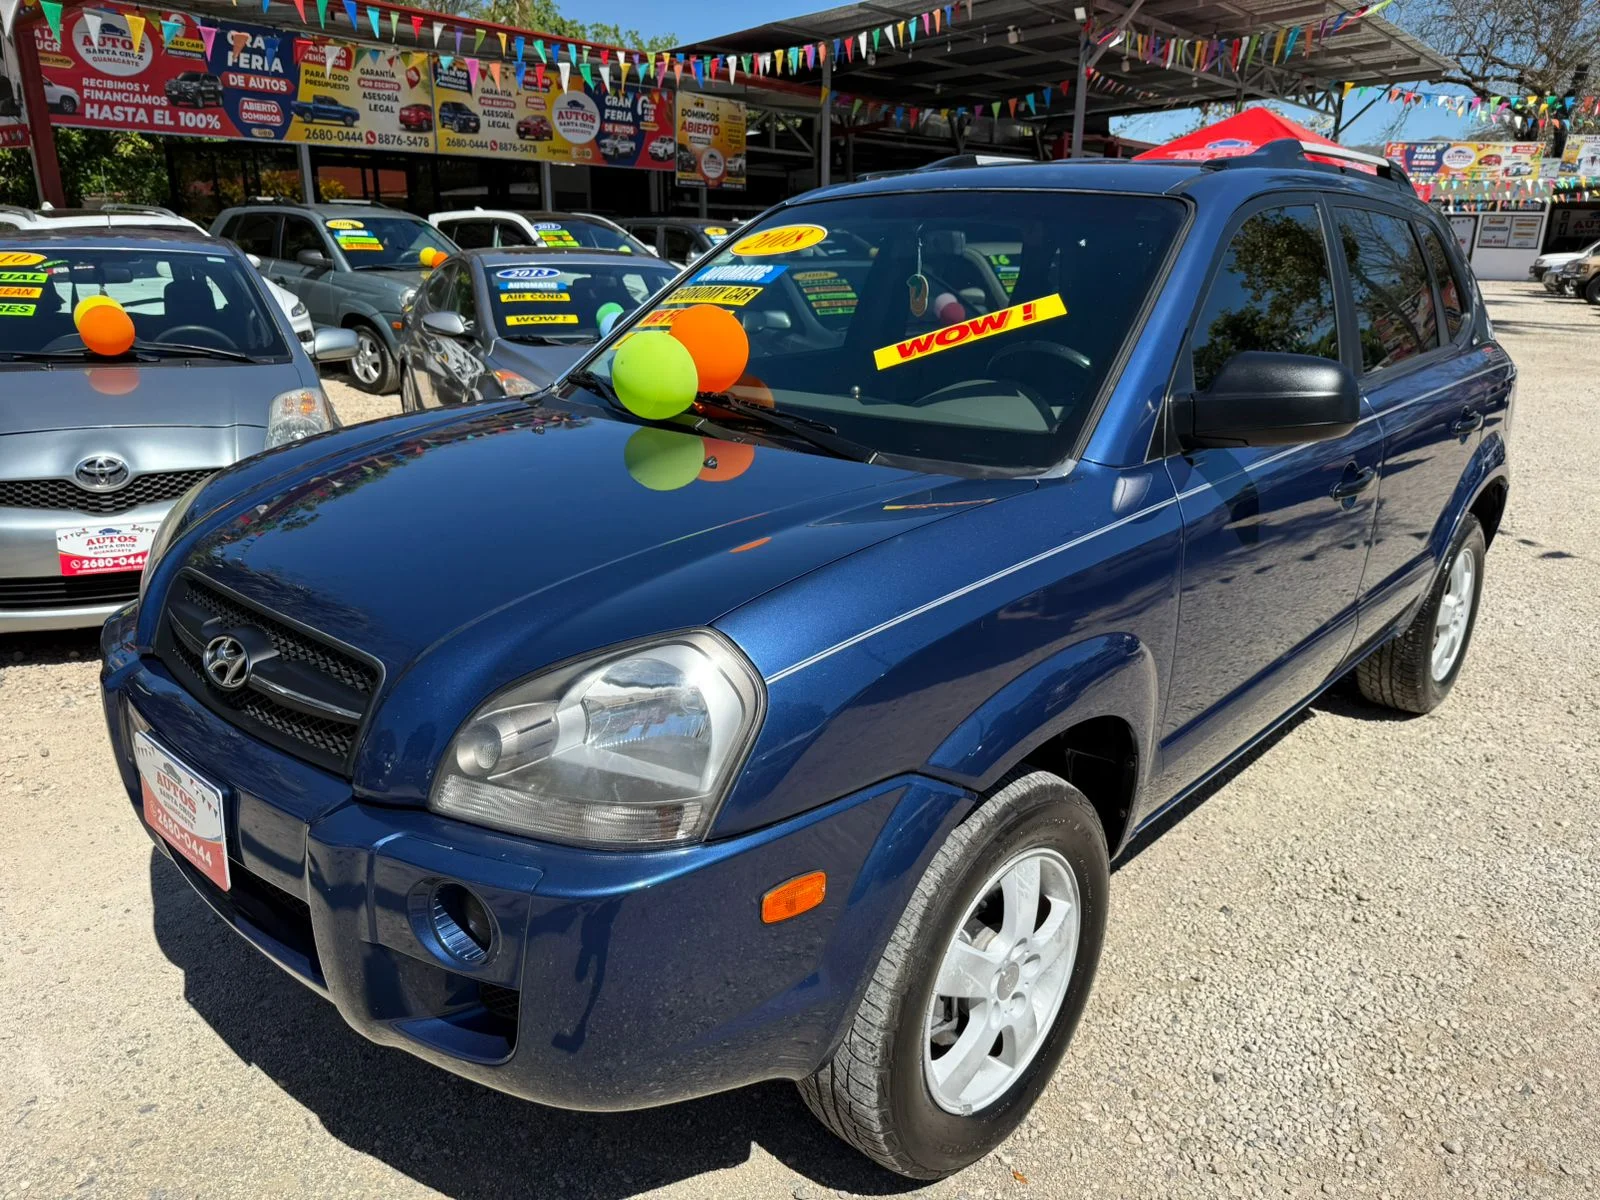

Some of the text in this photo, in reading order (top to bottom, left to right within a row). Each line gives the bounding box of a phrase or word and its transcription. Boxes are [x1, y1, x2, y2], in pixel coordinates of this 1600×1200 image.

[36, 40, 61, 52] UCR
[82, 34, 146, 53] AUTOS
[227, 30, 279, 52] GRA
[85, 48, 144, 61] SANTA CRUZ
[92, 56, 140, 67] GUANACASTE
[227, 51, 284, 73] FERIA
[305, 69, 350, 82] PARA TODO
[360, 68, 396, 79] GARANTÍA
[82, 78, 150, 92] RECIBIMOS Y
[228, 74, 287, 92] DE AUTOS
[305, 78, 350, 91] PRESUPUESTO
[360, 80, 399, 90] POR ESCRITO
[83, 90, 168, 106] FINANCIAMOS
[363, 91, 400, 102] ASESORÍA
[605, 96, 631, 108] GRAN
[243, 102, 277, 112] ABIERTO
[369, 103, 396, 113] LEGAL
[85, 103, 221, 129] HASTA EL 100%
[242, 111, 281, 122] DOMINGOS
[482, 109, 514, 119] ASESORÍA
[557, 111, 596, 124] AUTOS
[604, 109, 633, 122] FERIA
[681, 109, 720, 122] DOMINGOS
[487, 120, 511, 129] LEGAL
[604, 124, 613, 133] DE
[614, 125, 634, 135] AUTOS
[681, 120, 720, 136] ABIERTO
[305, 128, 430, 147] 2680-0444 8876-5478
[446, 137, 537, 153] 2680-0444 8876-5478
[739, 229, 815, 249] 2008
[512, 269, 548, 277] 2013
[669, 286, 757, 302] ECONOMY CAR
[897, 310, 1013, 359] WOW
[86, 535, 138, 546] AUTOS
[157, 771, 197, 814] AUTOS
[159, 787, 197, 824] SANTA CRUZ
[157, 809, 212, 867] 2680-0444
